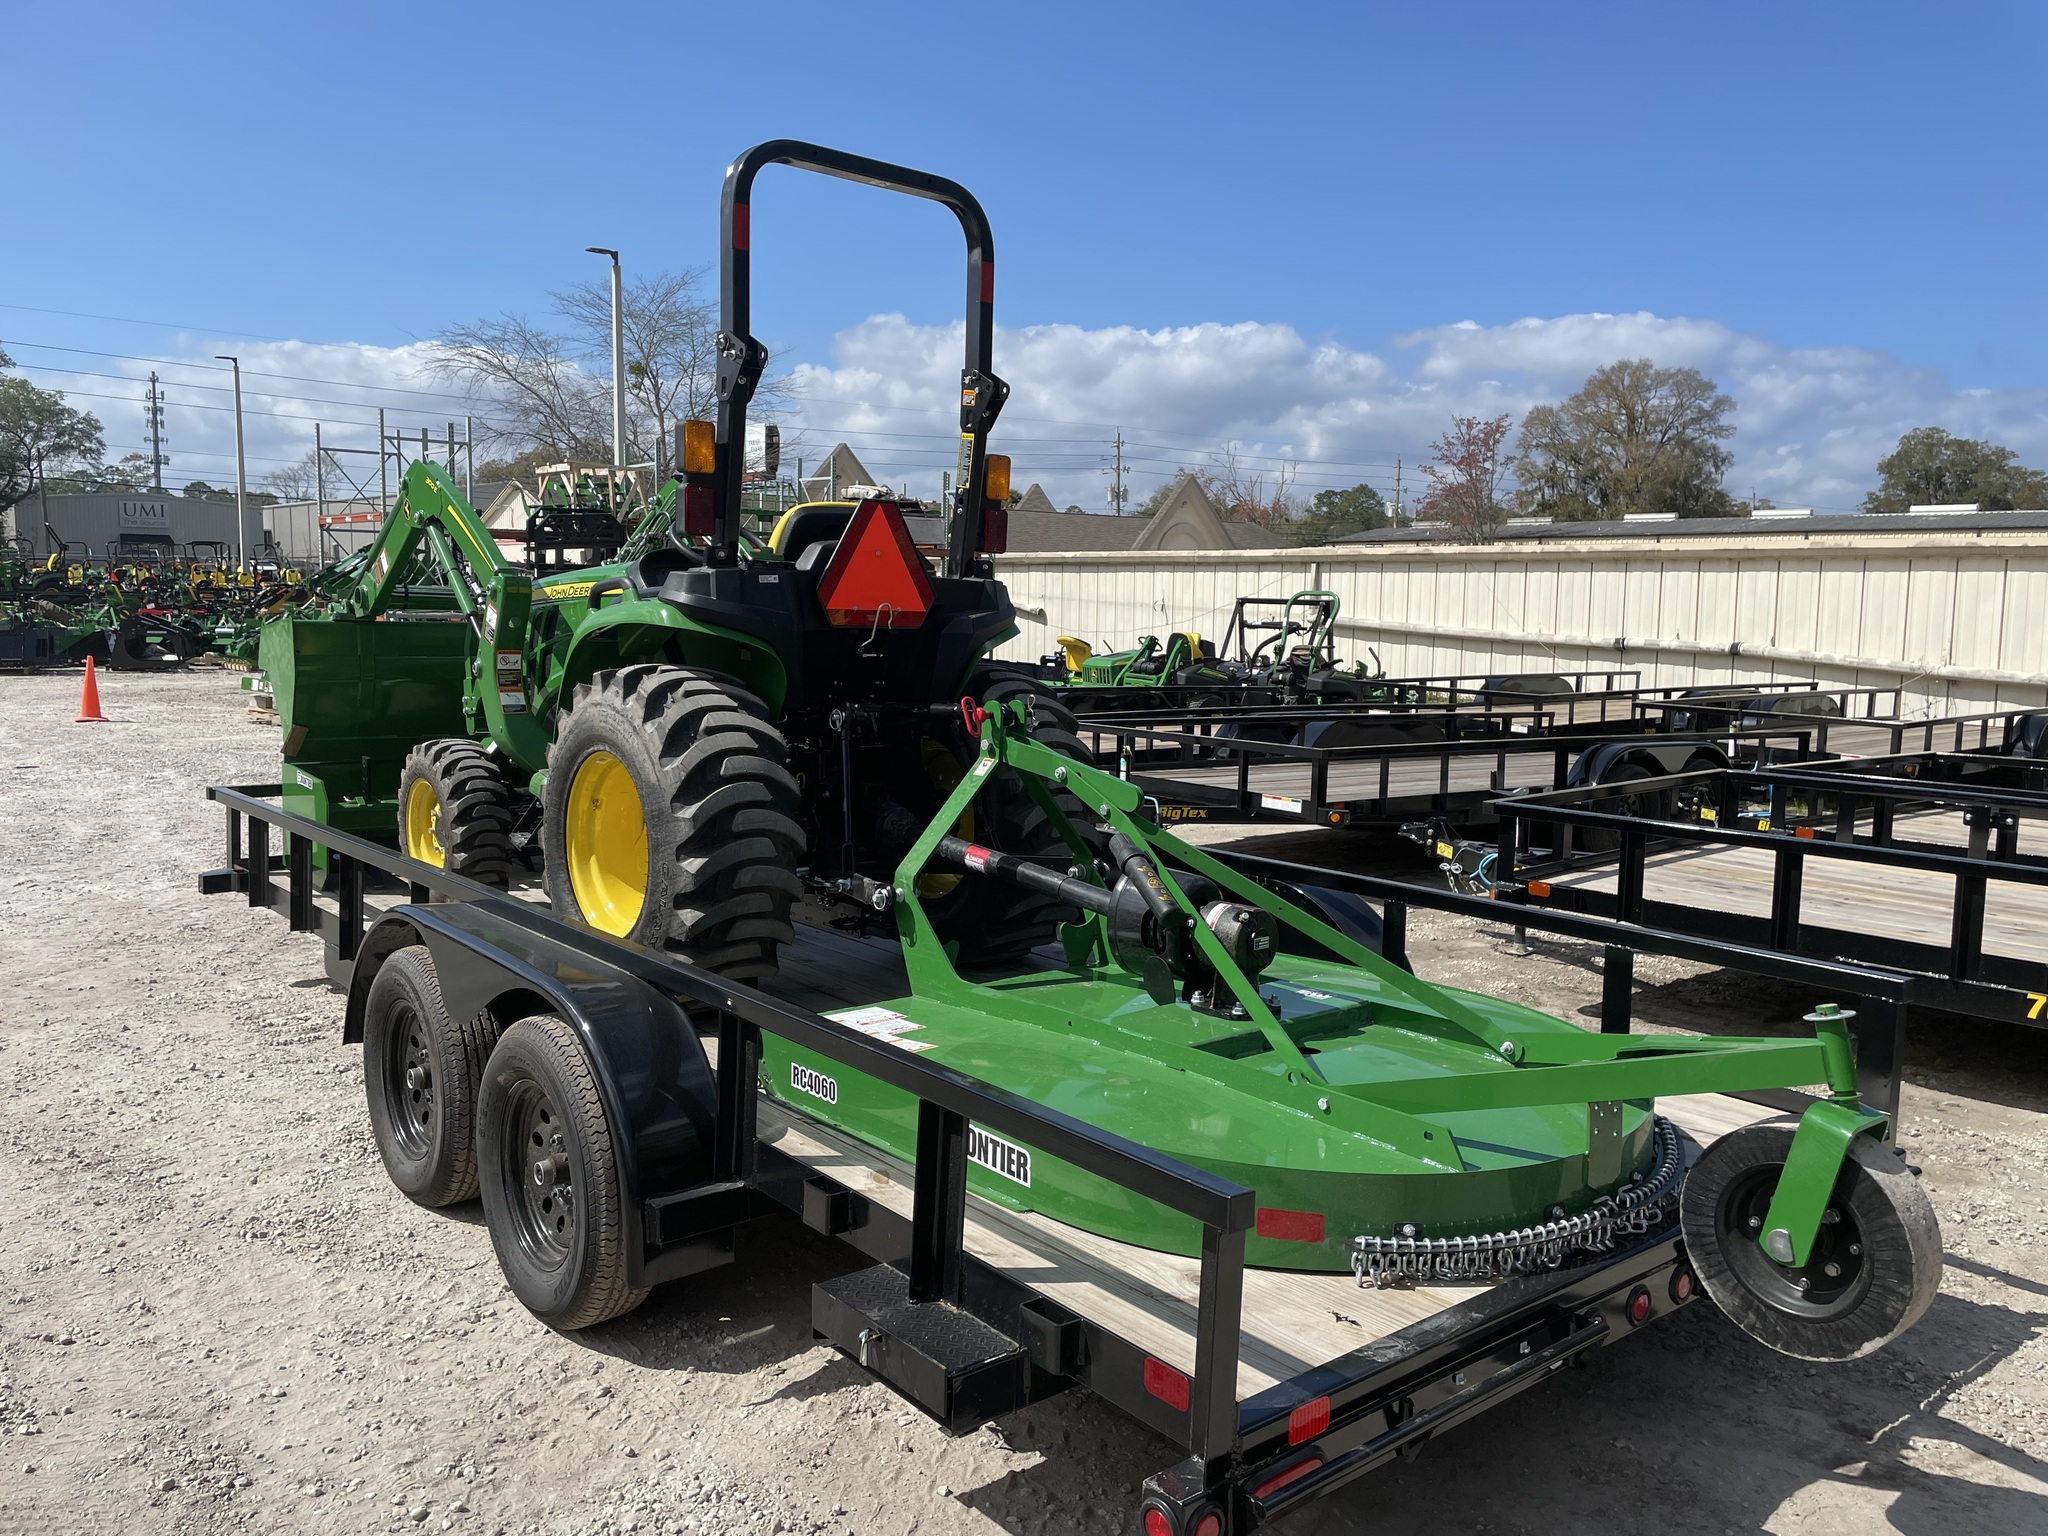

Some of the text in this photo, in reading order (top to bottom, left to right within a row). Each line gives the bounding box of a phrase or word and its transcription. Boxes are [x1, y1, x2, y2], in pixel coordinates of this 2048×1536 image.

[122, 502, 165, 518] UMI
[549, 585, 593, 598] JOHN DEER
[792, 1063, 837, 1103] RC4060
[968, 1127, 1029, 1185] ONTIER
